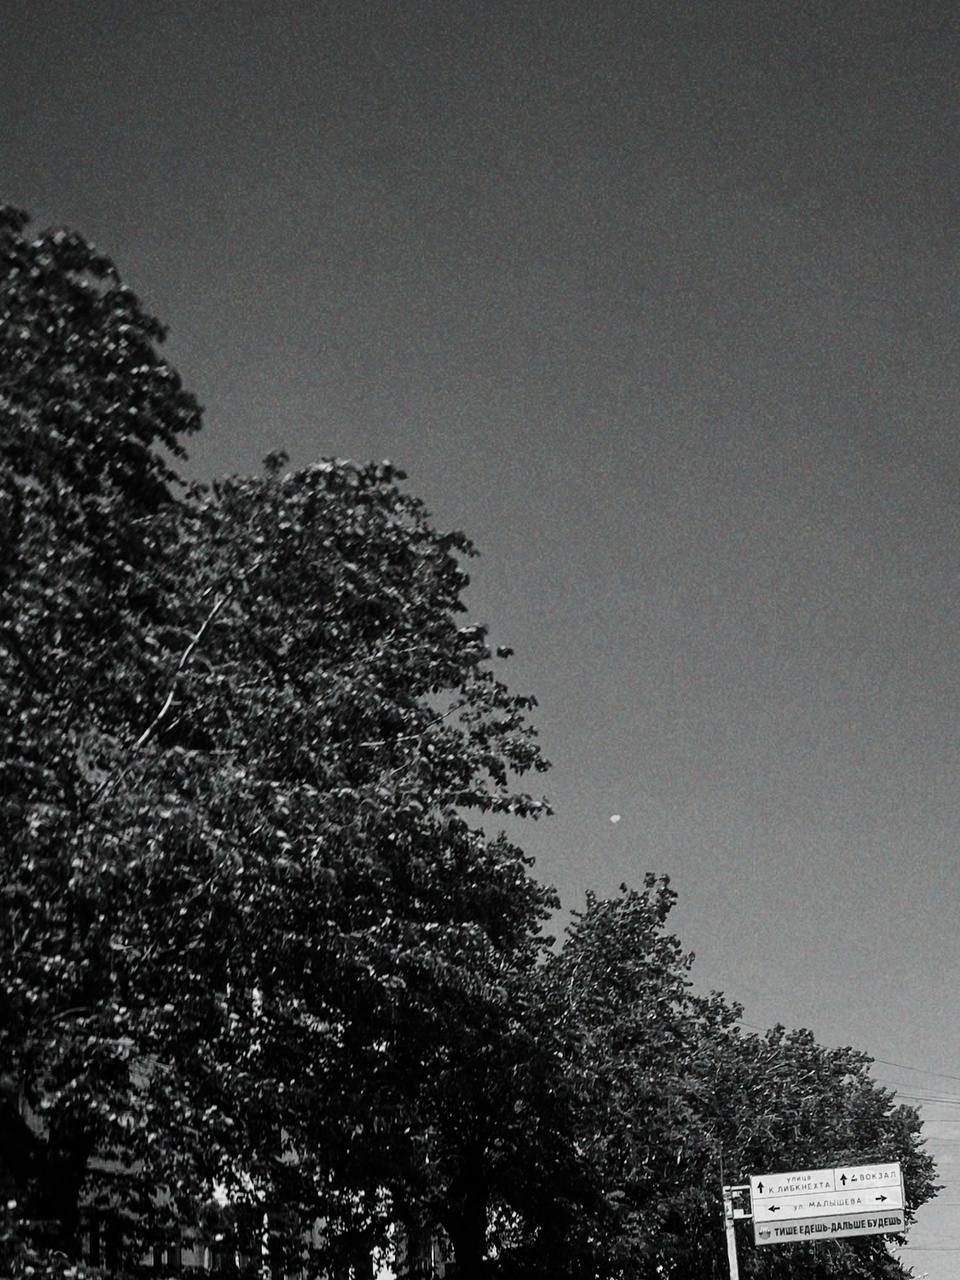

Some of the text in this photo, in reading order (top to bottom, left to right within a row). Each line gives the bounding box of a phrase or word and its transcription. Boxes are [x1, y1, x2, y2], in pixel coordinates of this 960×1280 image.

[859, 1171, 897, 1181] ВОКЗАЛ
[777, 1181, 832, 1193] ЛИБКНЕХТА
[808, 1197, 862, 1208] МАЛЫШЕВА
[774, 1226, 799, 1236] ТИШЕ
[868, 1217, 902, 1228] БУДЕШЬ
